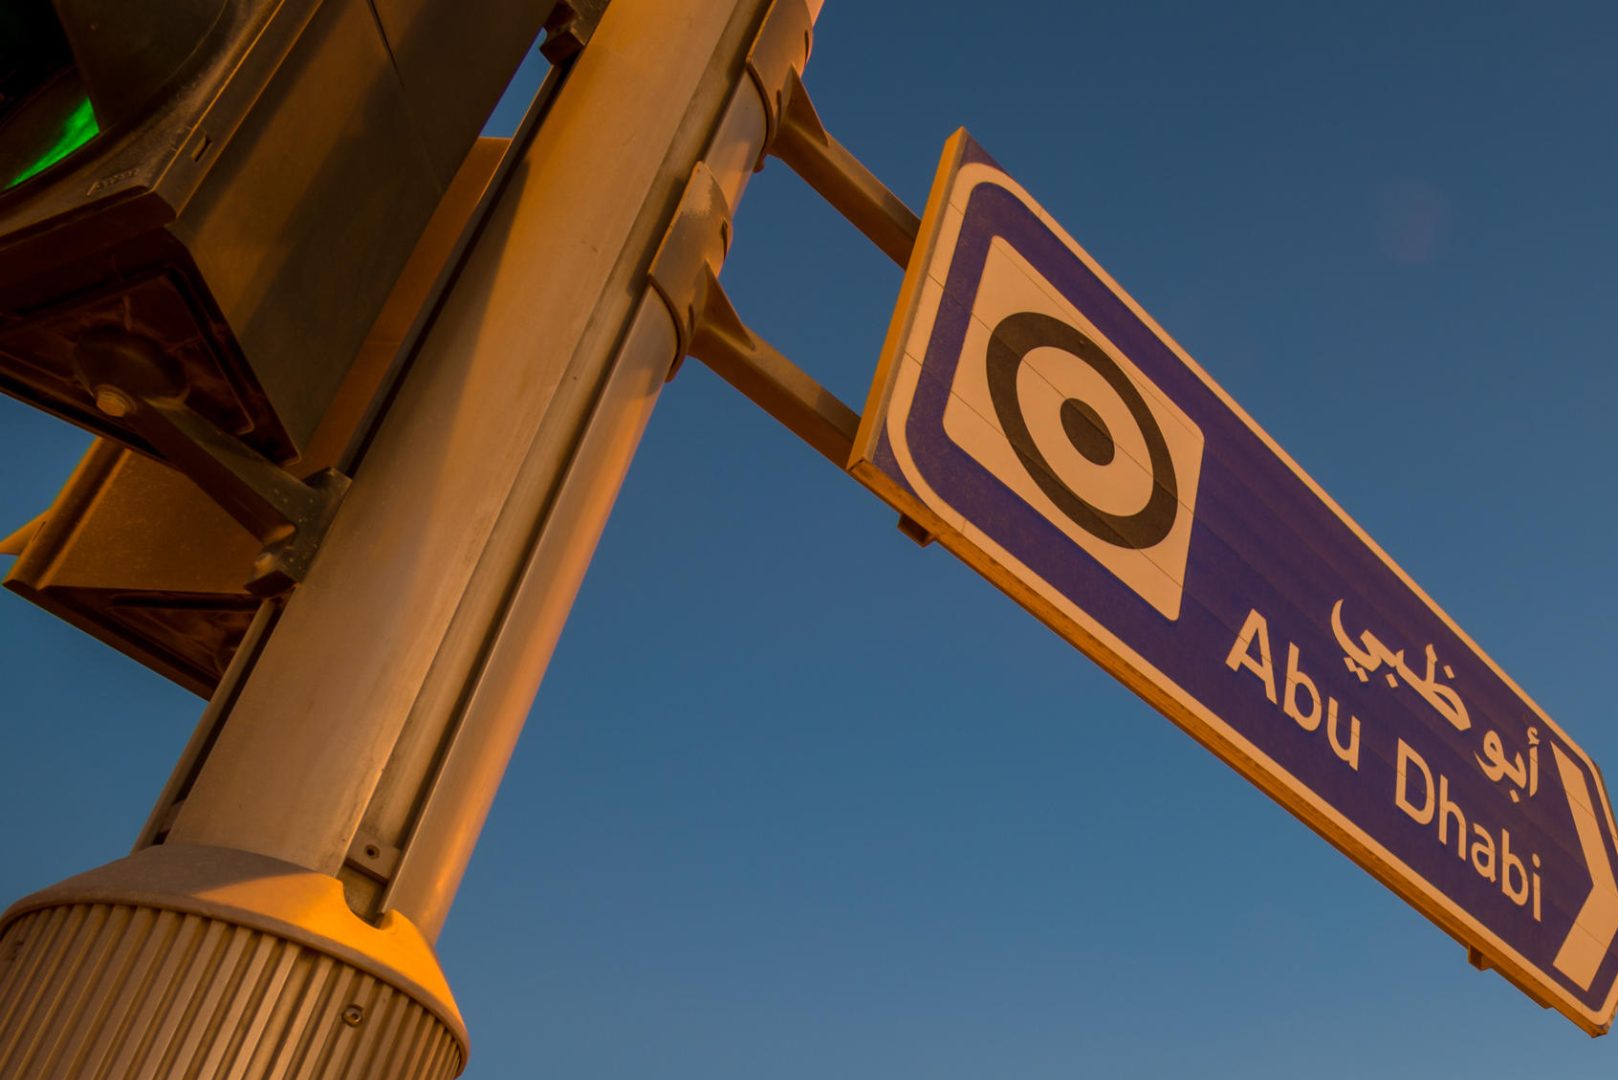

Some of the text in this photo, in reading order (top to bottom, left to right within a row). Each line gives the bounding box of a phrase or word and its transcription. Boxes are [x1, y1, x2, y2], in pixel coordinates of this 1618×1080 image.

[1225, 608, 1542, 923] Abu Dhabi
[1331, 599, 1541, 803] أبو ظبي
